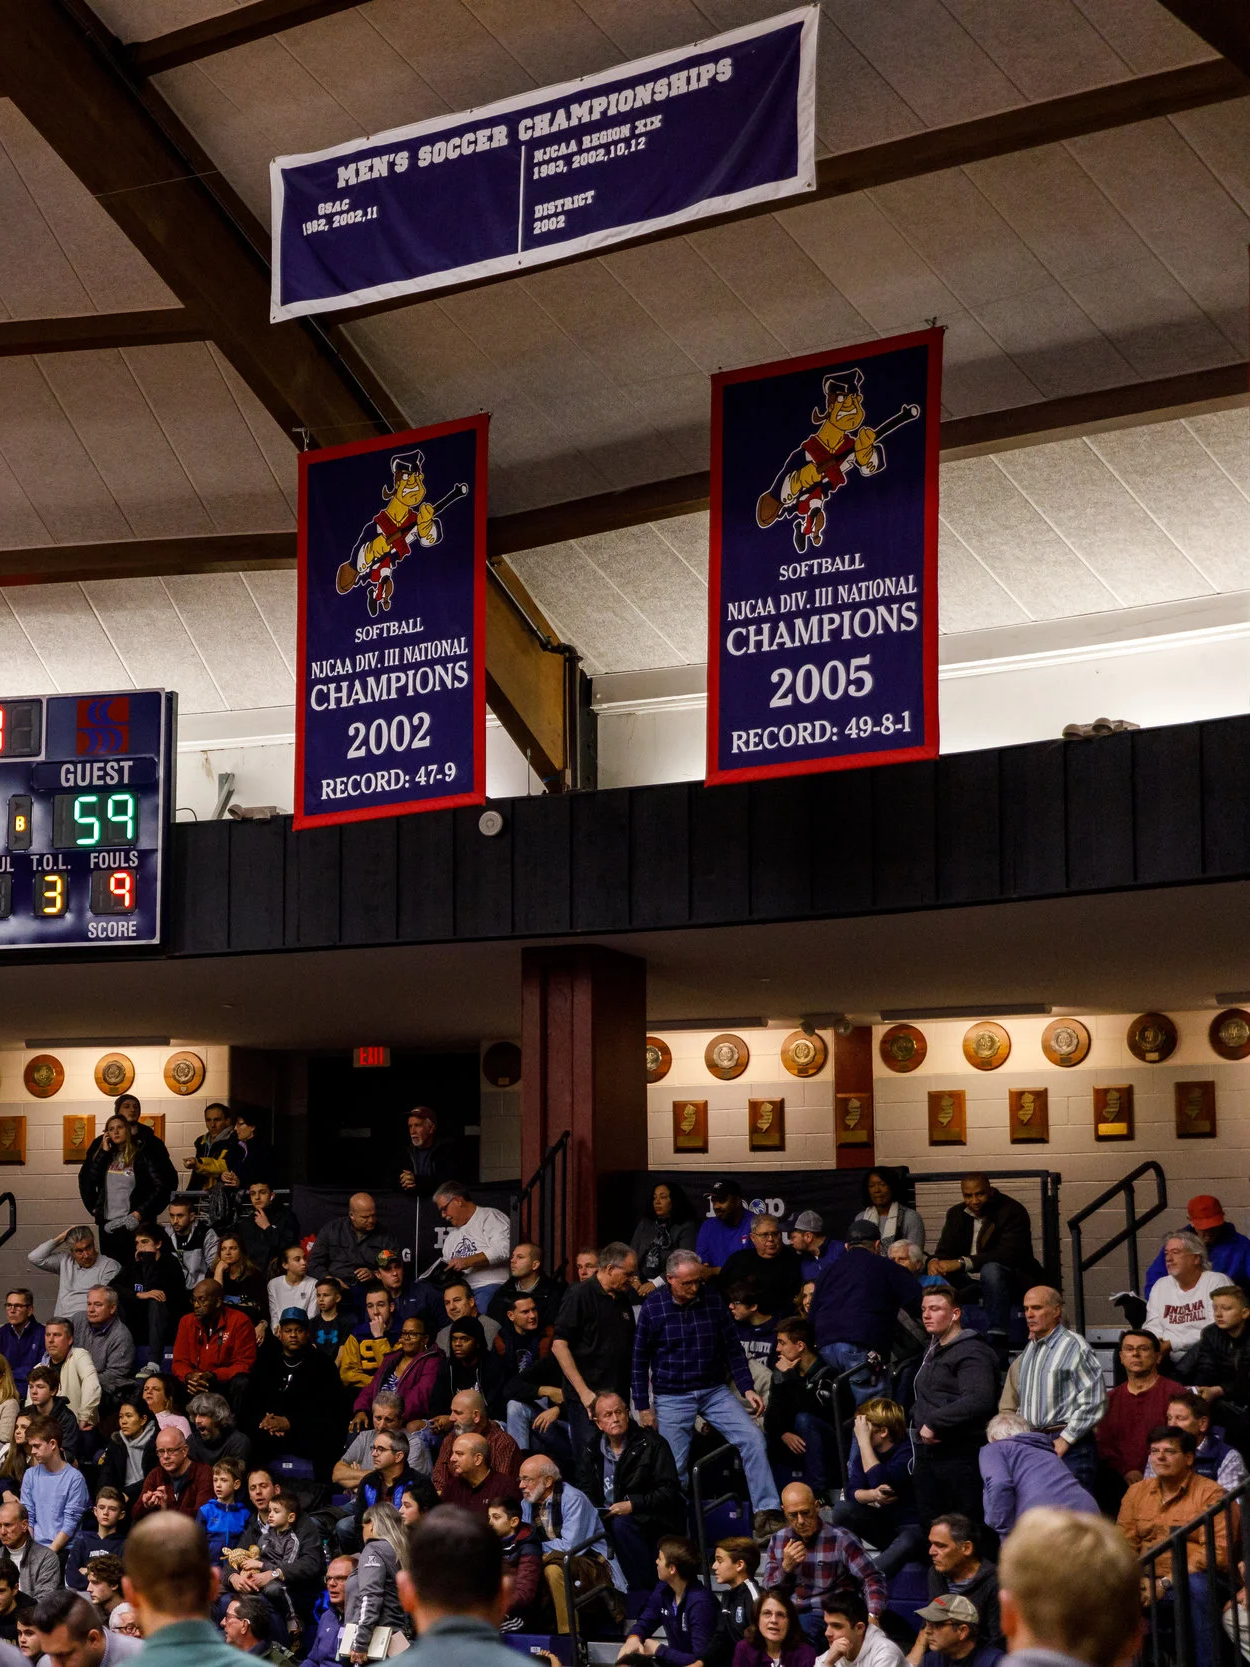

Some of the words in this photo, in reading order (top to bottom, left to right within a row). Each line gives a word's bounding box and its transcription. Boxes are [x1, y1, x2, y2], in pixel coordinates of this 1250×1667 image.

[336, 150, 409, 190] MEN'S
[417, 124, 509, 167] SOCCER
[518, 57, 733, 142] CHAMPIONSHIPS
[533, 139, 577, 164] NJCAA
[582, 126, 631, 152] REGION
[634, 114, 663, 136] XIX
[317, 198, 350, 216] GSAC
[534, 191, 595, 219] DISTRICT
[533, 215, 566, 235] 2002
[779, 553, 865, 581] SOFTBALL
[727, 597, 776, 621] NJCAA
[780, 591, 811, 613] DIV.
[814, 586, 833, 607] III
[838, 574, 918, 603] NATIONAL
[354, 617, 424, 643] SOFTBALL
[726, 601, 918, 656] CHAMPIONS
[311, 658, 353, 679] NJCAA
[356, 652, 381, 673] DIV.
[384, 648, 399, 667] III
[403, 637, 468, 664] NATIONAL
[310, 661, 469, 711] CHAMPIONS
[769, 654, 873, 709] 2005
[346, 711, 431, 759] 2002
[731, 720, 838, 754] RECORD:
[845, 710, 911, 739] 49-8-1
[60, 760, 134, 787] GUEST
[321, 769, 410, 801] RECORD:
[415, 762, 457, 786] 47-9
[74, 794, 134, 845] 59
[31, 854, 71, 871] T.O.L.
[90, 850, 139, 868] FOULS
[43, 875, 62, 913] 3
[109, 872, 133, 907] 9
[88, 921, 137, 939] SCORE
[360, 1046, 384, 1064] EXIT
[1163, 1300, 1205, 1319] INDIANA
